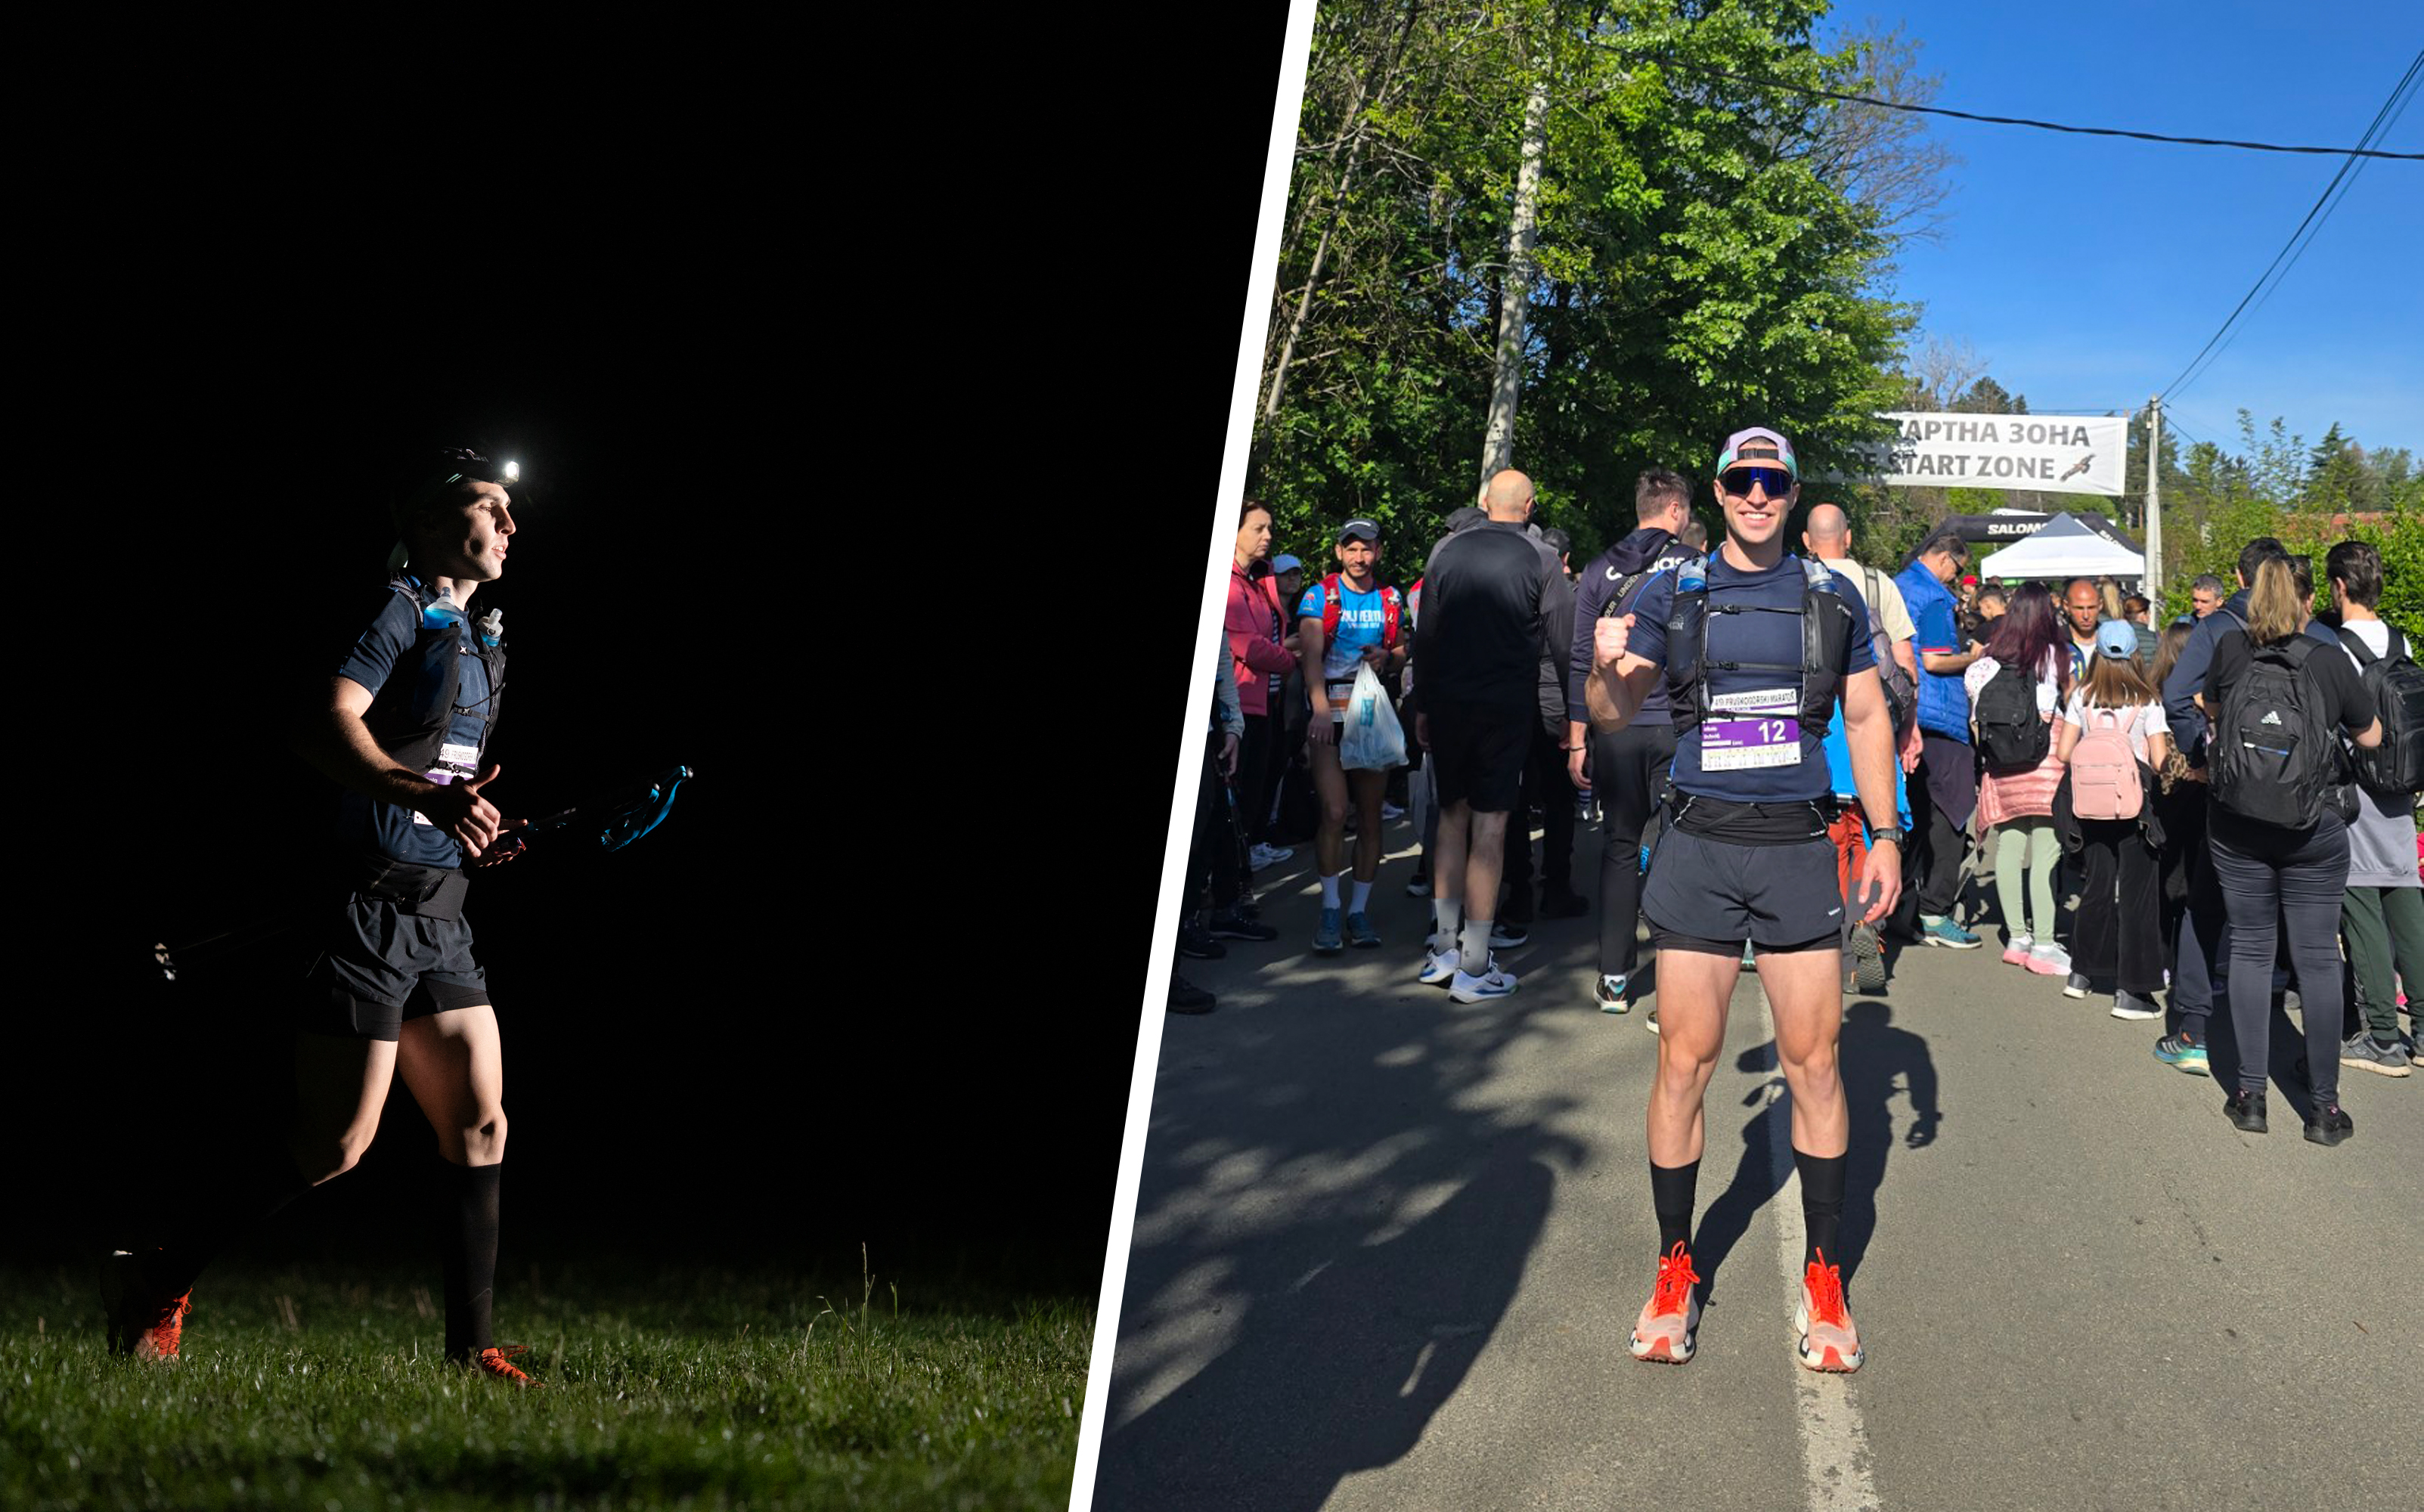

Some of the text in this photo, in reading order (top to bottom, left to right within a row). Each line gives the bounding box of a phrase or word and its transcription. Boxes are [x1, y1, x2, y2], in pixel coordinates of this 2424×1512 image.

[1900, 419, 2091, 448] АРТНА ЗОНА
[1976, 455, 2055, 480] ZONE
[1988, 522, 2047, 535] SALOM
[1758, 720, 1786, 743] 12
